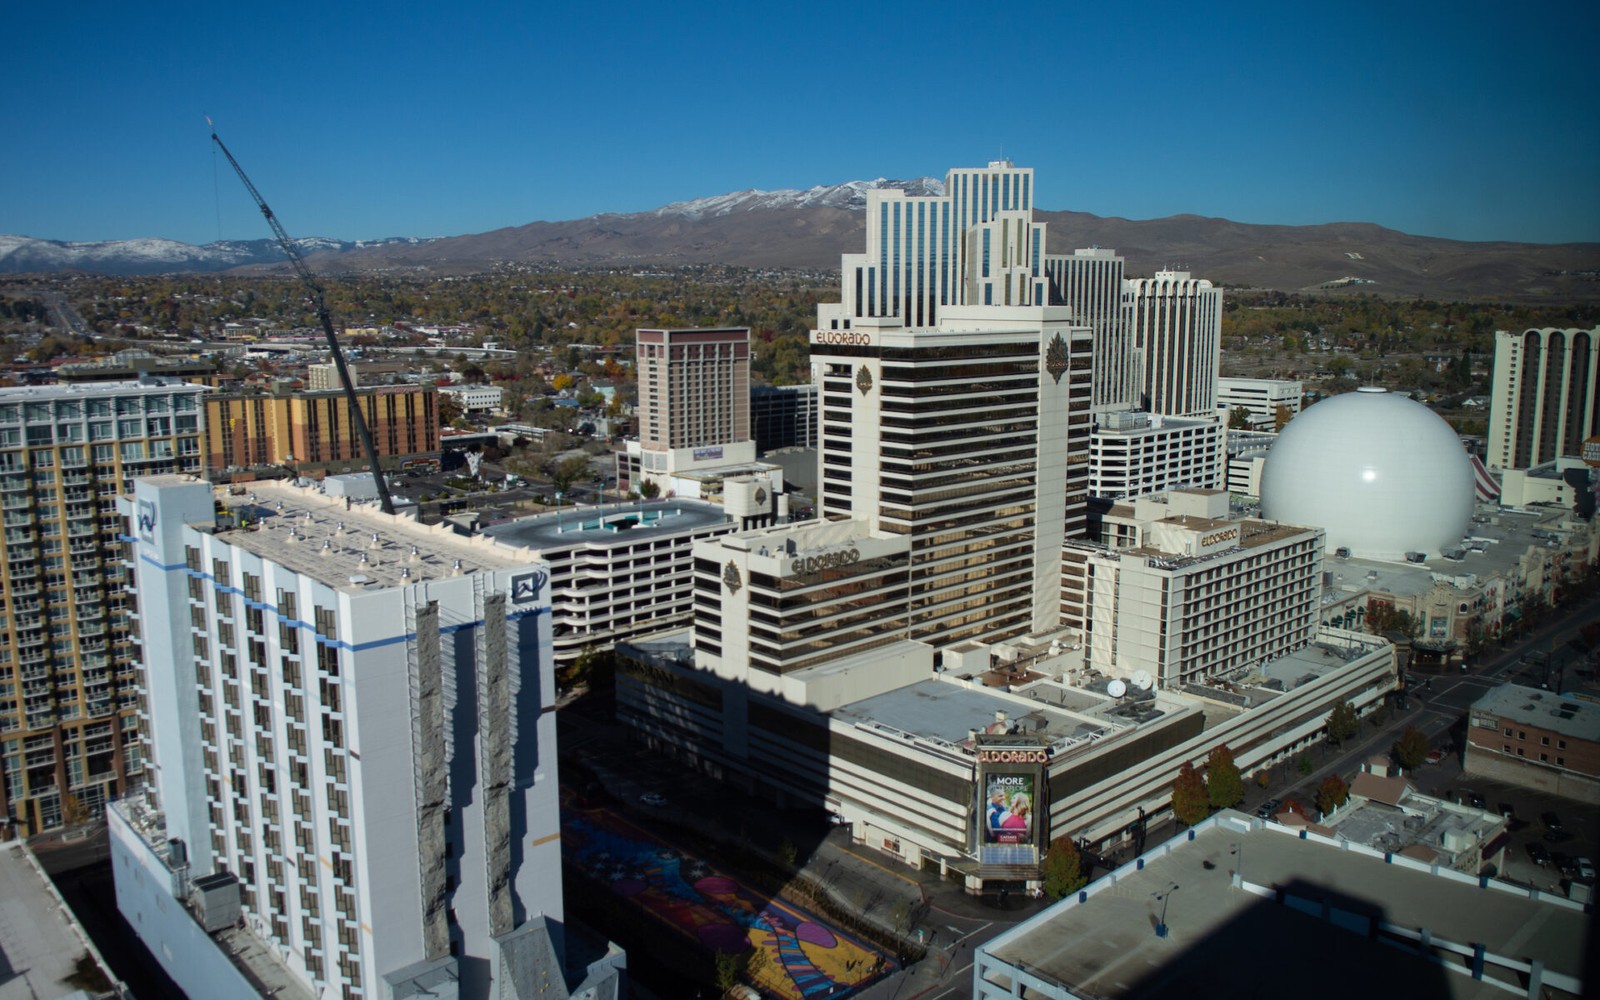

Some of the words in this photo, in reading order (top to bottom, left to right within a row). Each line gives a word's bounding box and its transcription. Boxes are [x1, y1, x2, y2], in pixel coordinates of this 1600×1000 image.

[816, 331, 871, 346] ELDORADO
[977, 751, 1047, 763] ELDORADO
[997, 777, 1024, 785] MORE
